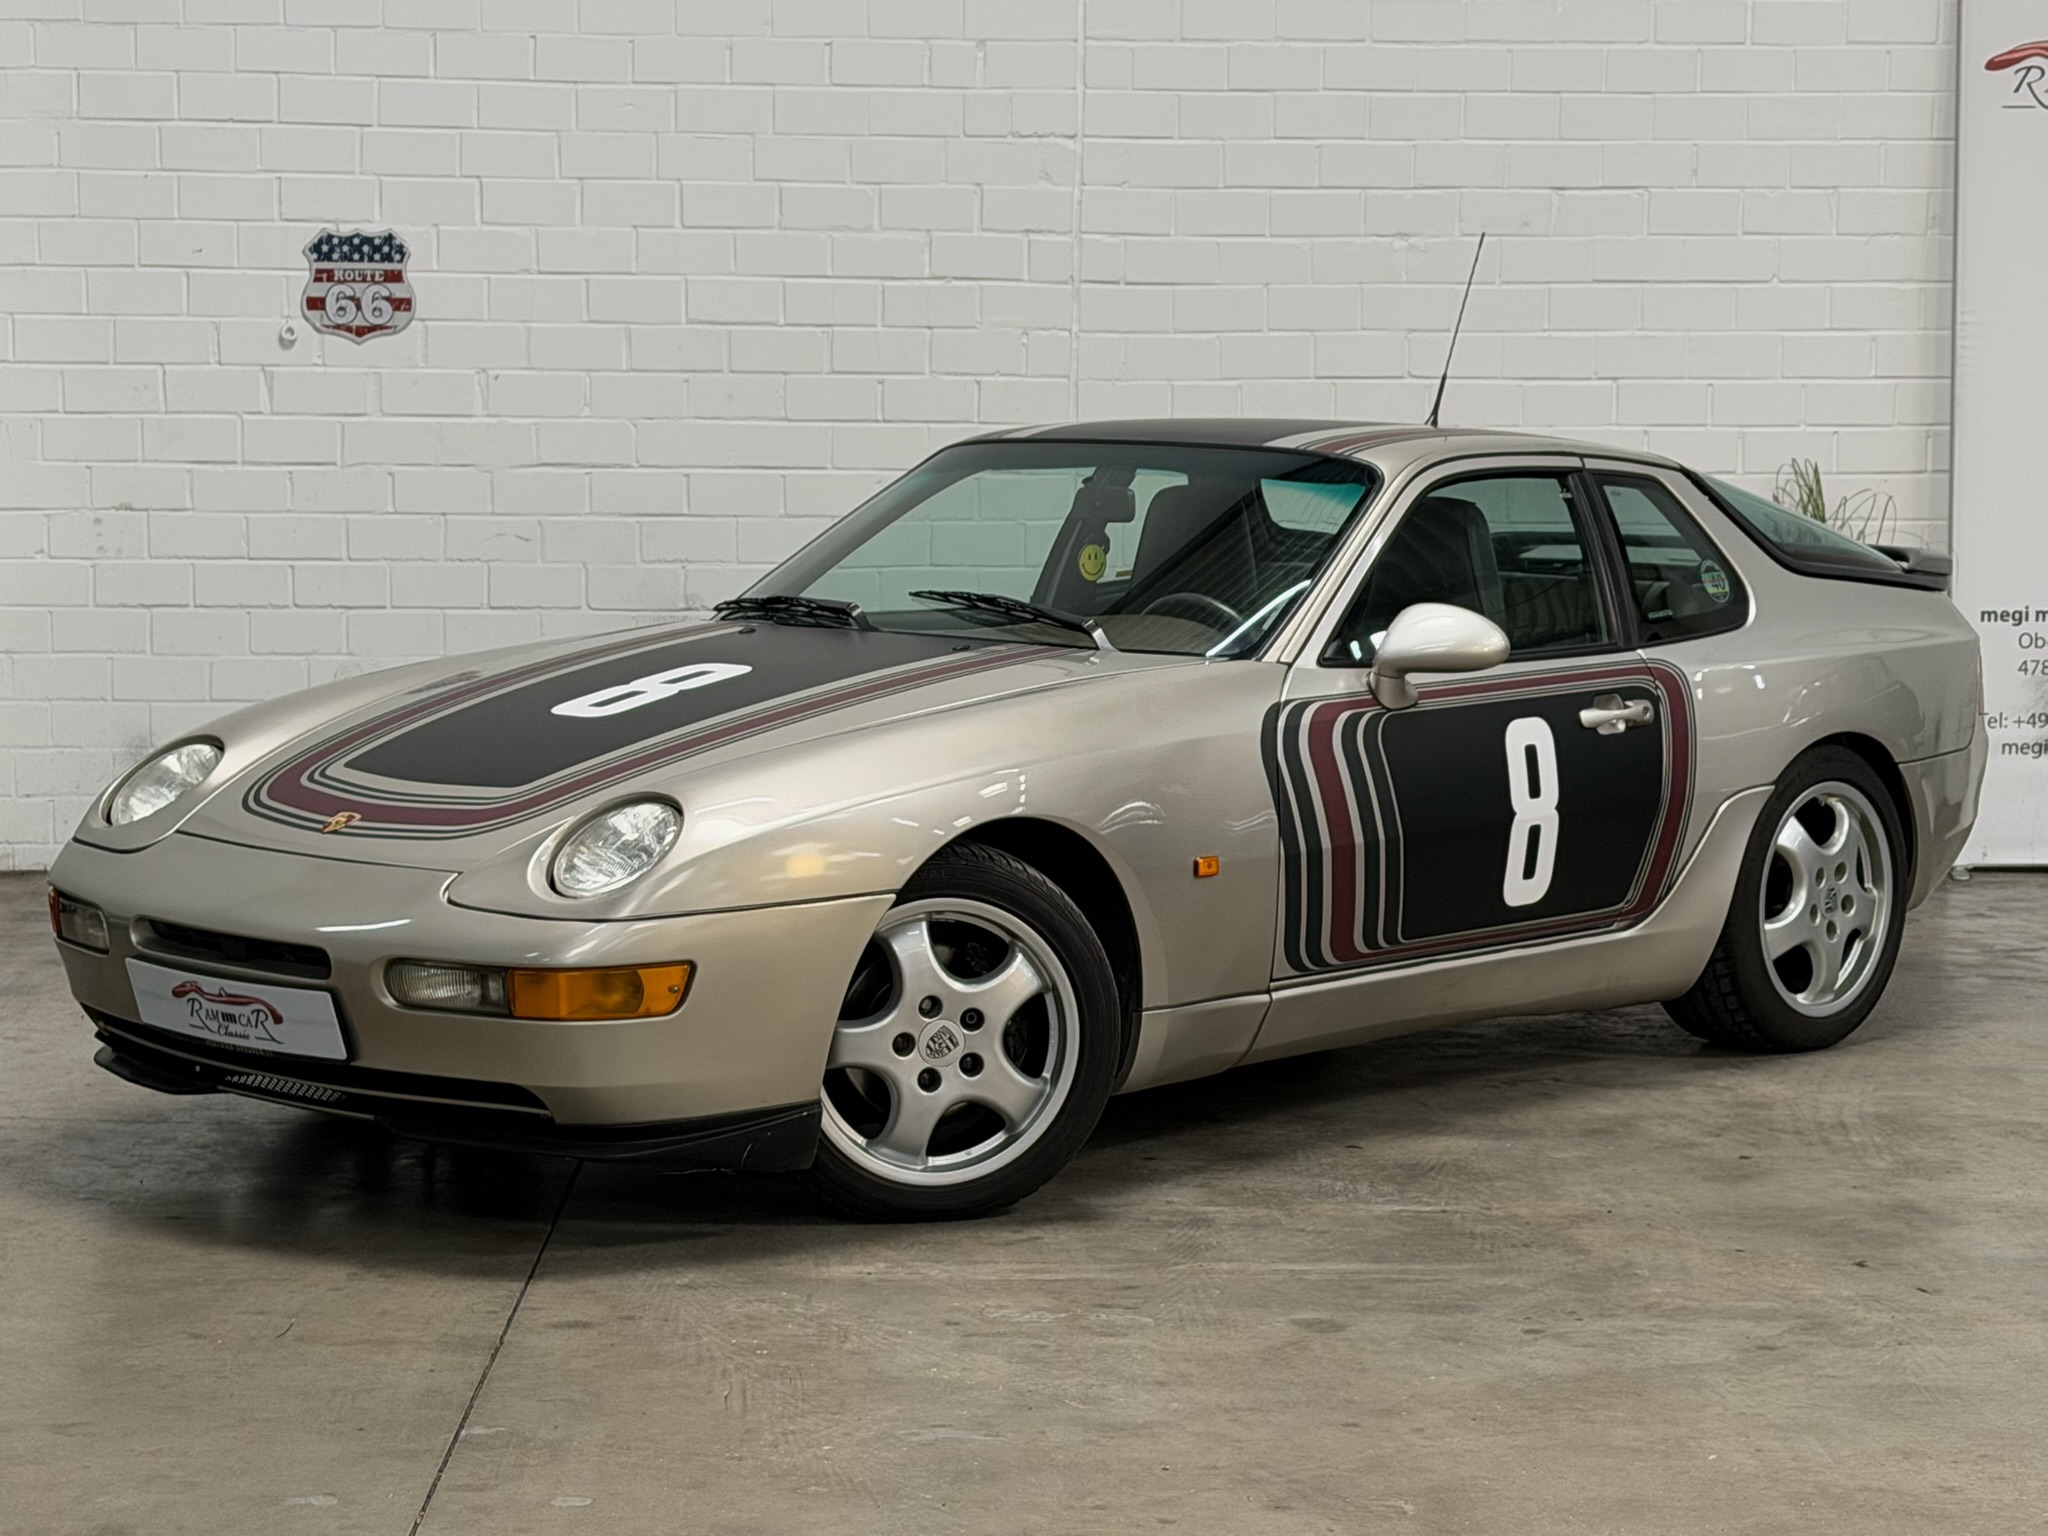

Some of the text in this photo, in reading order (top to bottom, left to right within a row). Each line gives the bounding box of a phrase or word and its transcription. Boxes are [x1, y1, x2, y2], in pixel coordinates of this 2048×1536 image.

[2013, 65, 2048, 110] R
[334, 270, 384, 281] ROUTE
[325, 283, 394, 325] 66
[1981, 605, 2029, 626] megi
[2018, 632, 2048, 649] Ob
[551, 663, 753, 717] 8
[1503, 716, 1559, 907] 8
[218, 1024, 250, 1040] Classic
